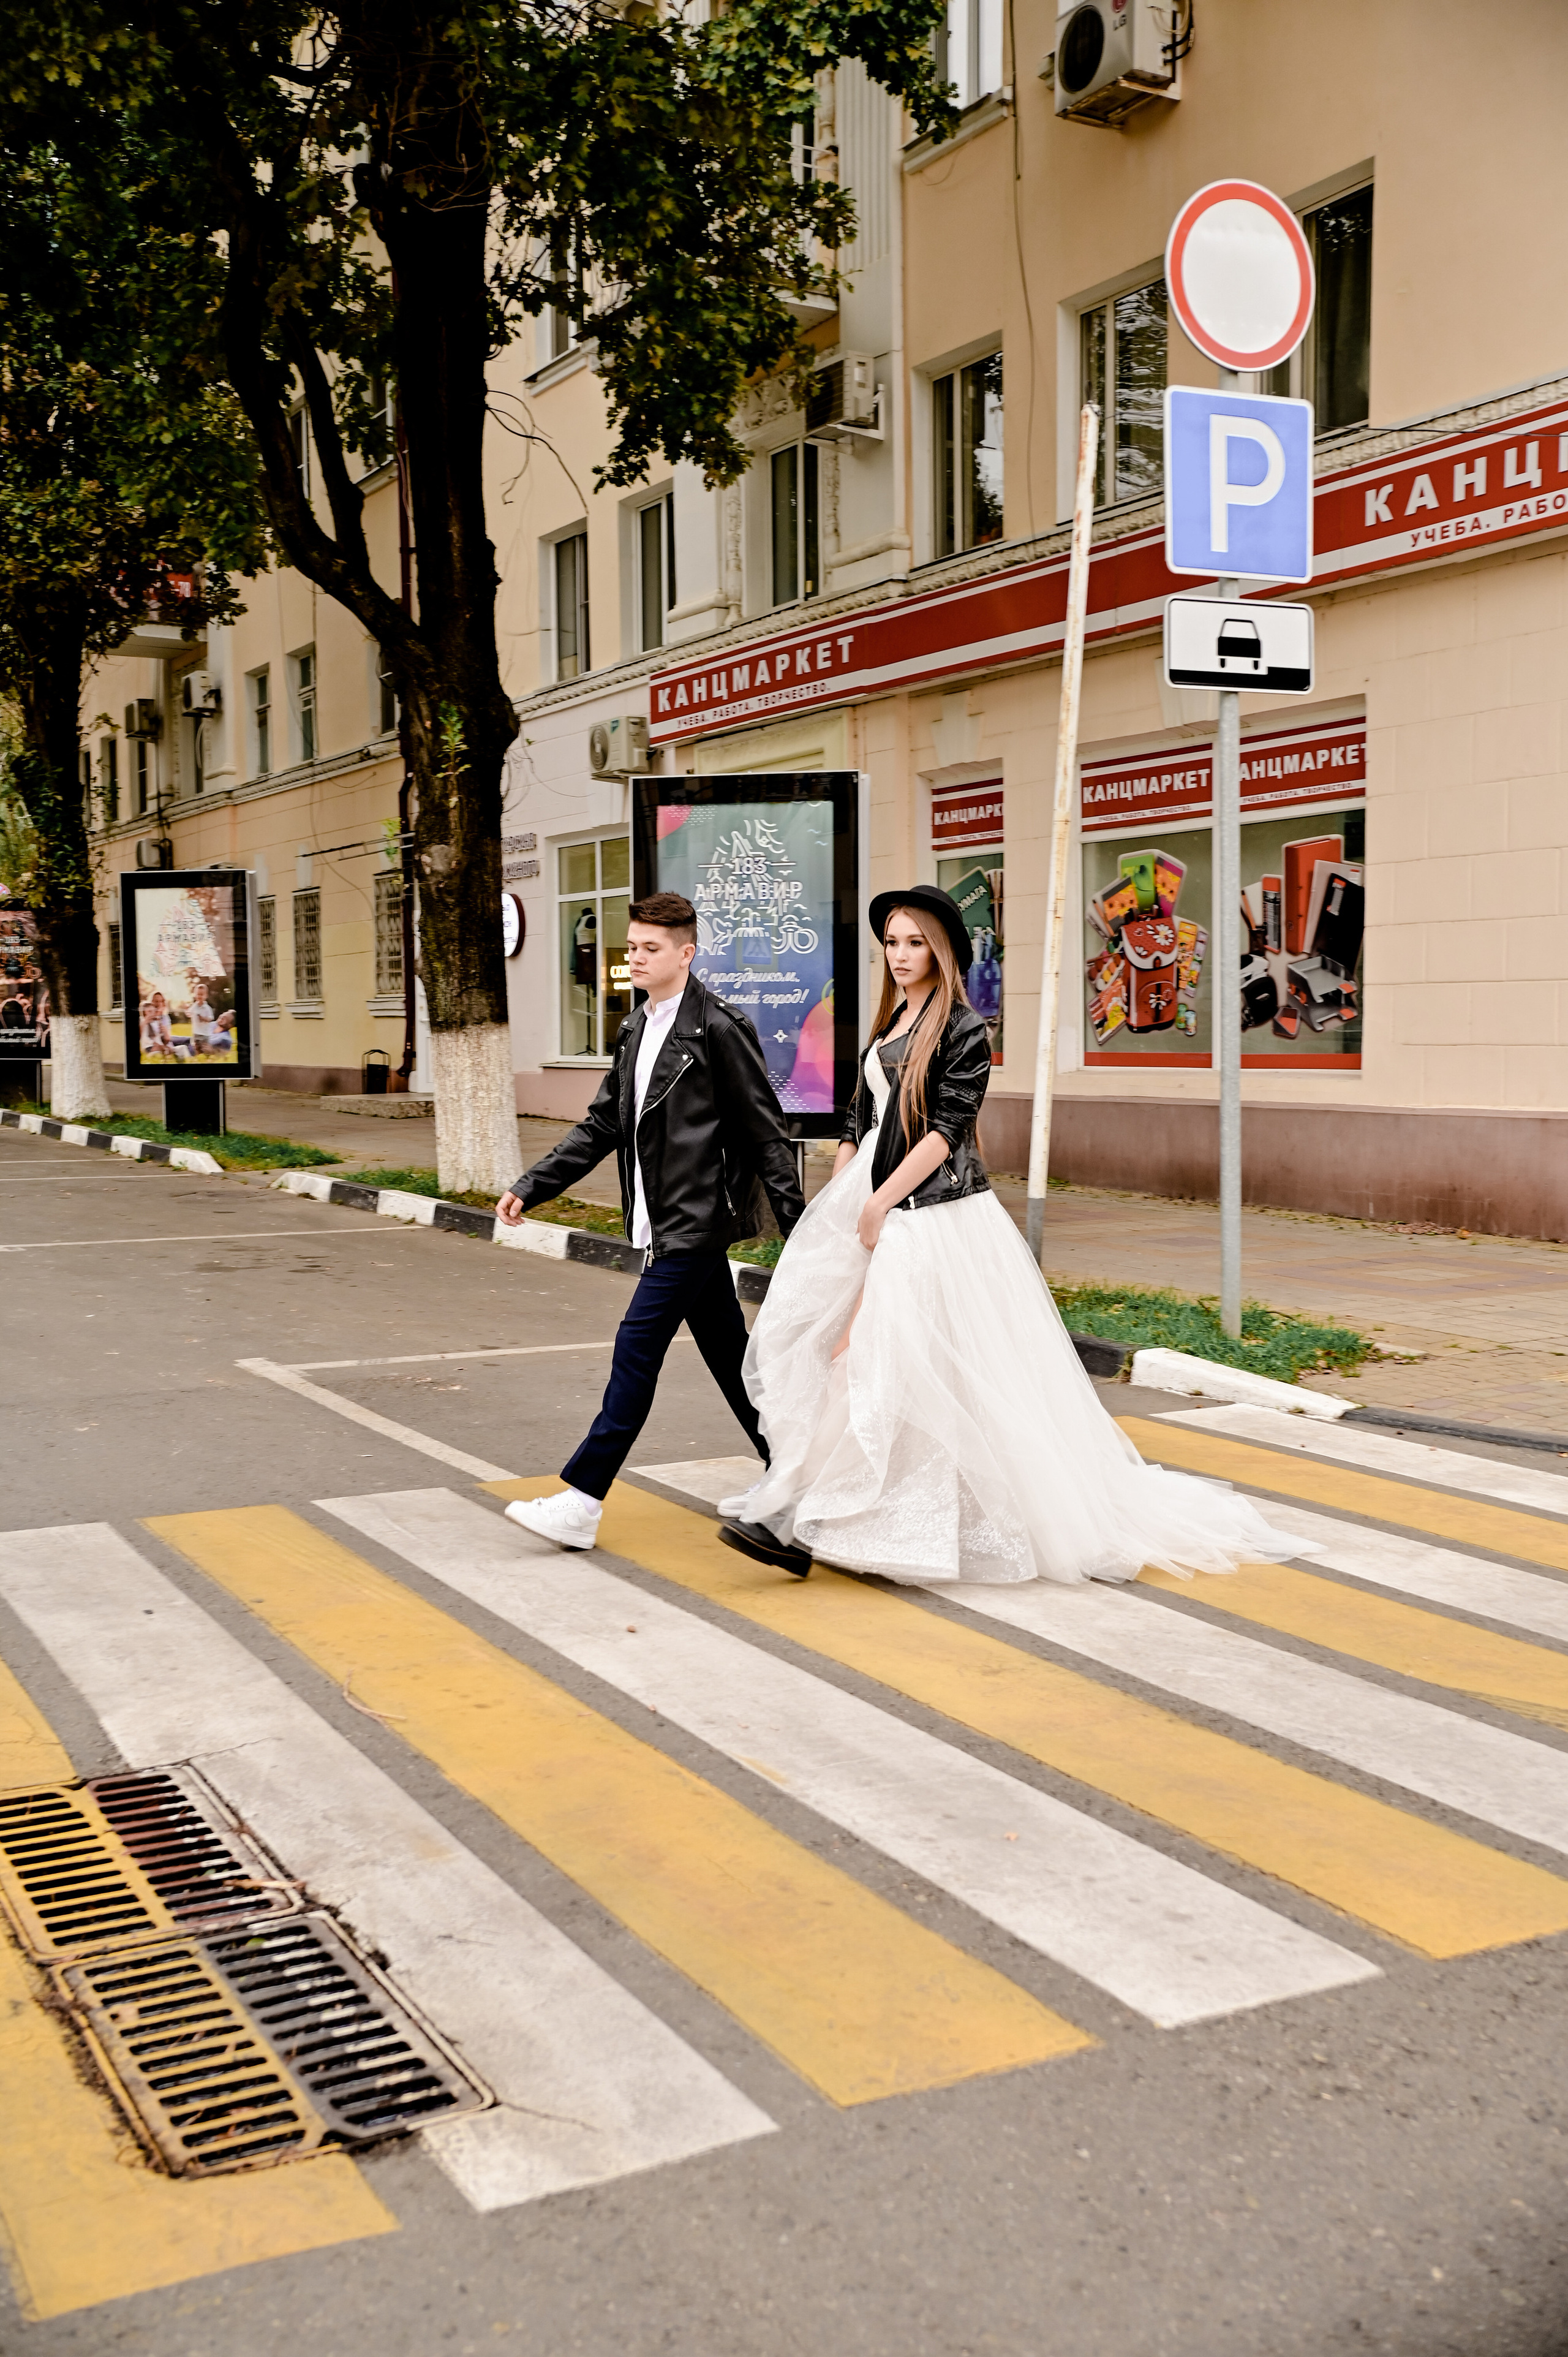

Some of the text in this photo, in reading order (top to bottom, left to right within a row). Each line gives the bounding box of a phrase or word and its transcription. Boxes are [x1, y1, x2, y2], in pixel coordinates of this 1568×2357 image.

[1210, 413, 1286, 553] P
[1364, 433, 1568, 527] КАНЦ
[1411, 516, 1491, 547] УЧЕБА.
[657, 635, 854, 713] КАНЦМАРКЕТ
[712, 700, 754, 721] РАБОТА.
[757, 682, 831, 709] ТВОРЧЕСТВО.
[1239, 743, 1366, 782] АНЦМАРКЕ
[1083, 768, 1211, 804] КАНЦМАРКЕТ
[934, 803, 1003, 825] КАНЦМАРК
[731, 856, 767, 875] 183
[693, 880, 803, 901] АРМАВИР
[696, 967, 709, 983] С
[761, 988, 810, 1009] город!
